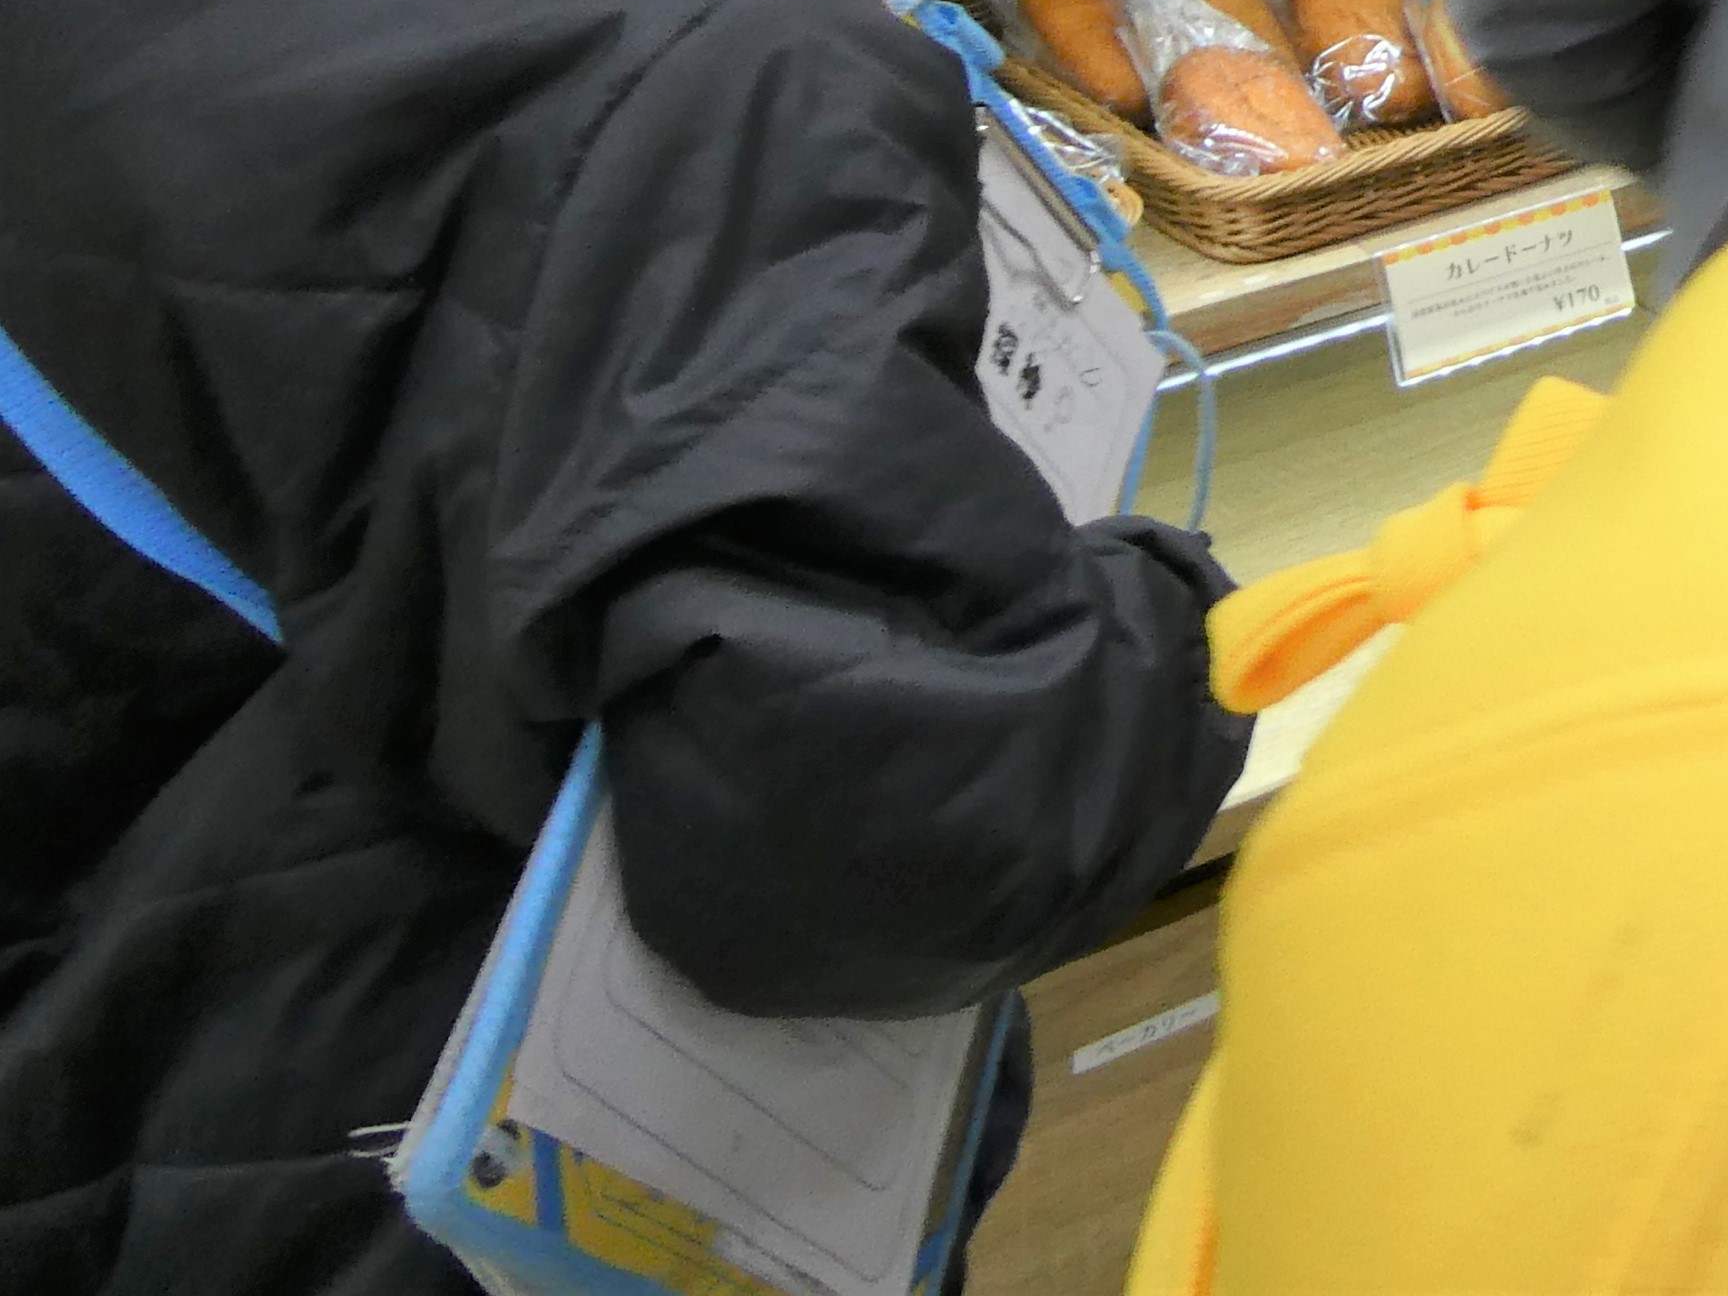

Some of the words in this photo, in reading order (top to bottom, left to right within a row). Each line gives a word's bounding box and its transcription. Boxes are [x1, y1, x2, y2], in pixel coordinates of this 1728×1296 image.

[1444, 227, 1574, 282] カレードーナツ
[1551, 283, 1602, 314] ¥170
